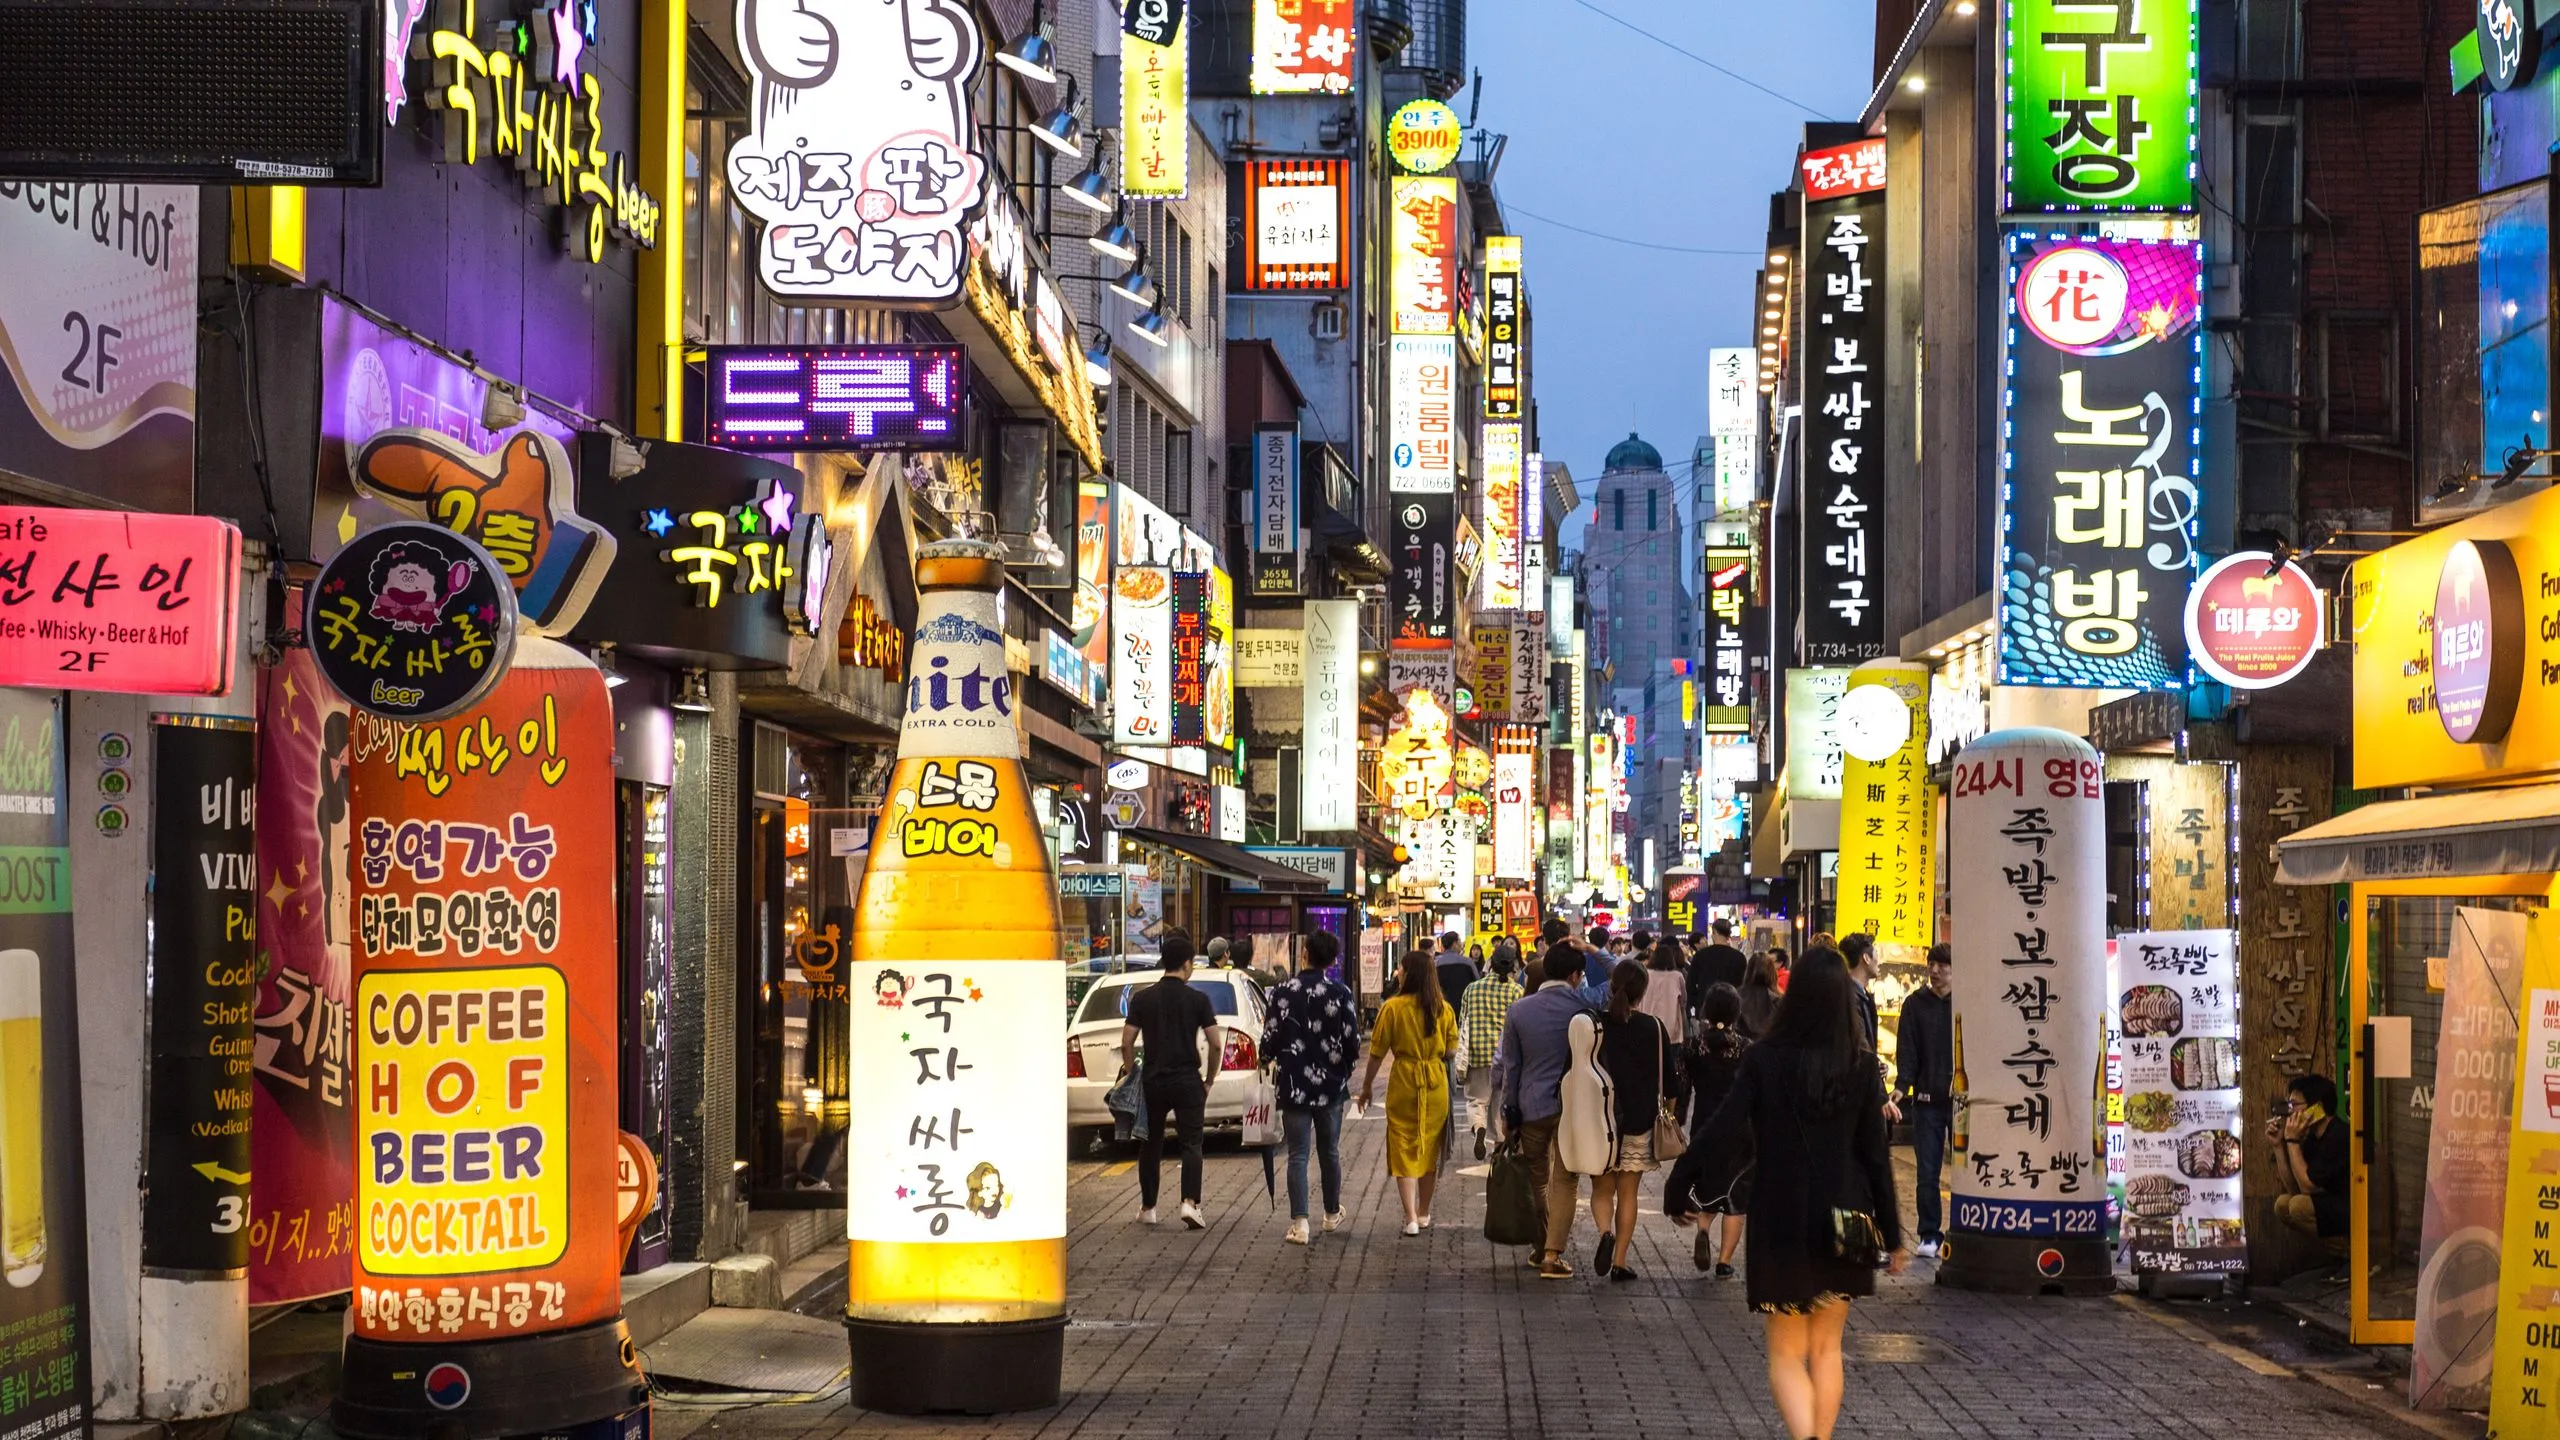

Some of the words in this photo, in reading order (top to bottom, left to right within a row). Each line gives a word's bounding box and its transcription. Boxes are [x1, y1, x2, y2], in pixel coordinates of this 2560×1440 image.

[617, 152, 659, 250] beer
[736, 151, 853, 219] 제주
[770, 221, 957, 288] 도야지
[2042, 269, 2105, 323] 花
[62, 311, 122, 394] 2F
[2053, 370, 2149, 654] 노래방
[671, 511, 793, 608] 국자
[1713, 589, 1744, 625] 락
[2215, 607, 2302, 641] 떼루와
[59, 651, 110, 673] 2F
[319, 596, 491, 677] 국자싸롱
[1177, 612, 1200, 707] 부대찌개
[2219, 653, 2233, 662] The
[2275, 653, 2297, 662] Juice
[372, 678, 424, 707] beer
[1480, 646, 1508, 700] 부동산
[1716, 624, 1744, 707] 노래방
[2238, 663, 2257, 672] Since
[907, 718, 947, 730] EXTRA
[953, 717, 997, 729] COLD
[1406, 737, 1436, 812] 주막
[1955, 757, 2024, 800] 24시
[2043, 758, 2100, 801] 영업
[361, 812, 557, 889] 흡연가능
[360, 886, 561, 958] 단체모임환영
[1510, 900, 1532, 917] W
[1667, 901, 1698, 933] 락
[368, 987, 546, 1046] COFFEE
[369, 1123, 545, 1186] BEER
[369, 1193, 547, 1256] COCKTAIL
[1960, 1201, 2098, 1233] 02)734-1222
[2534, 1220, 2550, 1240] M
[2533, 1248, 2558, 1269] XL
[360, 1280, 566, 1334] 편안한휴식공간
[2523, 1357, 2539, 1378] M
[2521, 1387, 2547, 1409] XL
